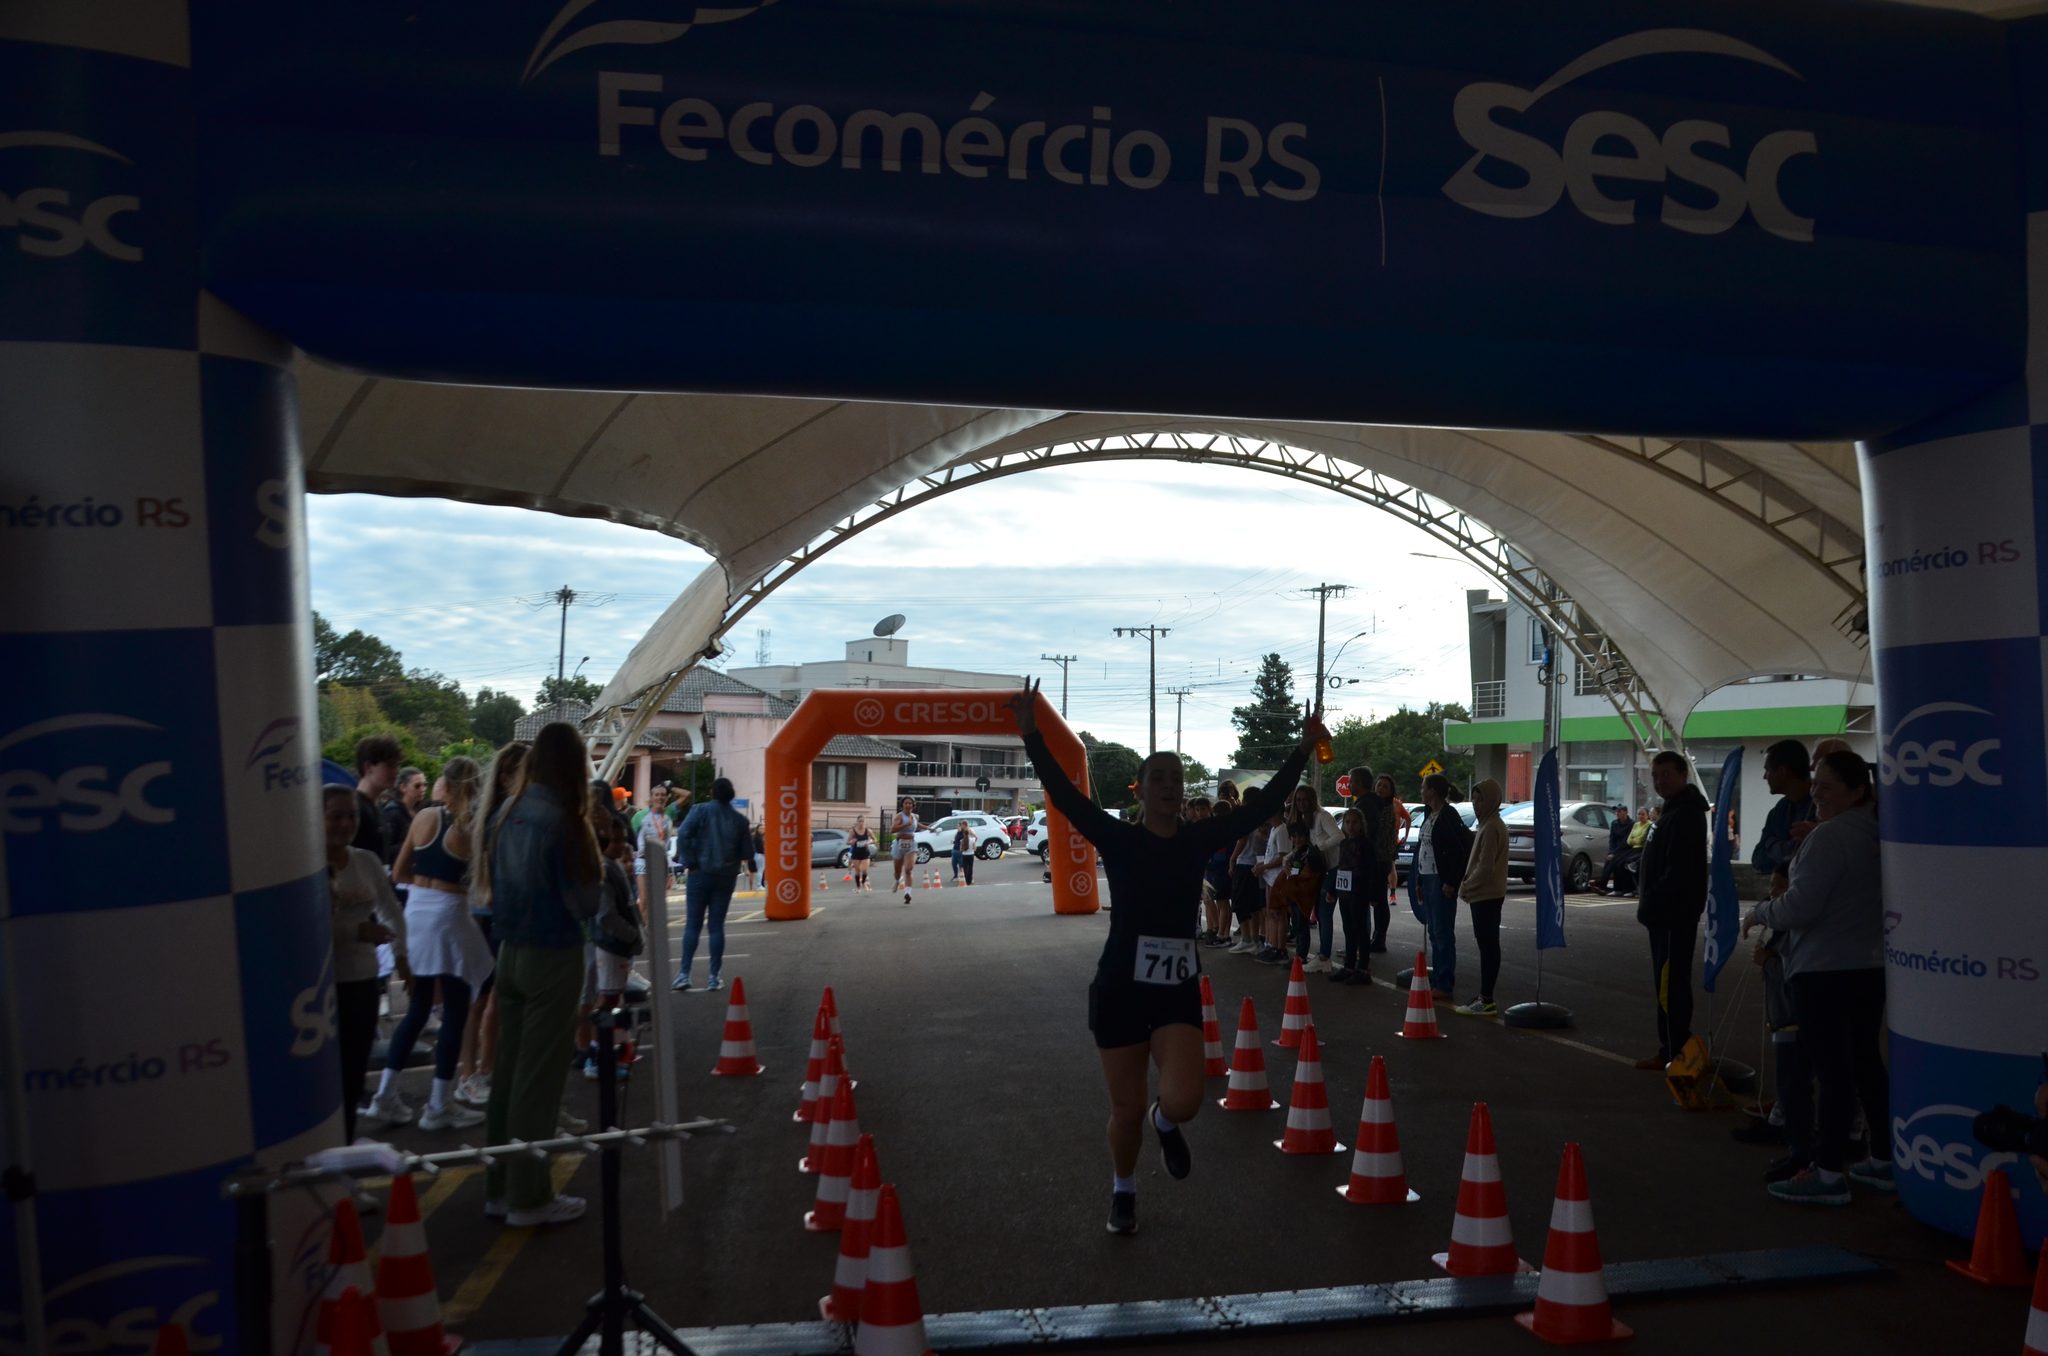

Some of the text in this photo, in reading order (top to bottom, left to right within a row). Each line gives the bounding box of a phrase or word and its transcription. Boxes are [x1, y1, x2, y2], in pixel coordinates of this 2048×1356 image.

[597, 69, 1322, 202] Fecomércio RS
[1441, 80, 1819, 244] Sesc
[136, 497, 192, 529] RS
[1978, 539, 2021, 566] RS
[893, 700, 1006, 725] CRESOL
[779, 777, 799, 873] CRESOL
[1145, 953, 1190, 981] 716
[1997, 956, 2040, 982] RS
[178, 1039, 232, 1076] RS
